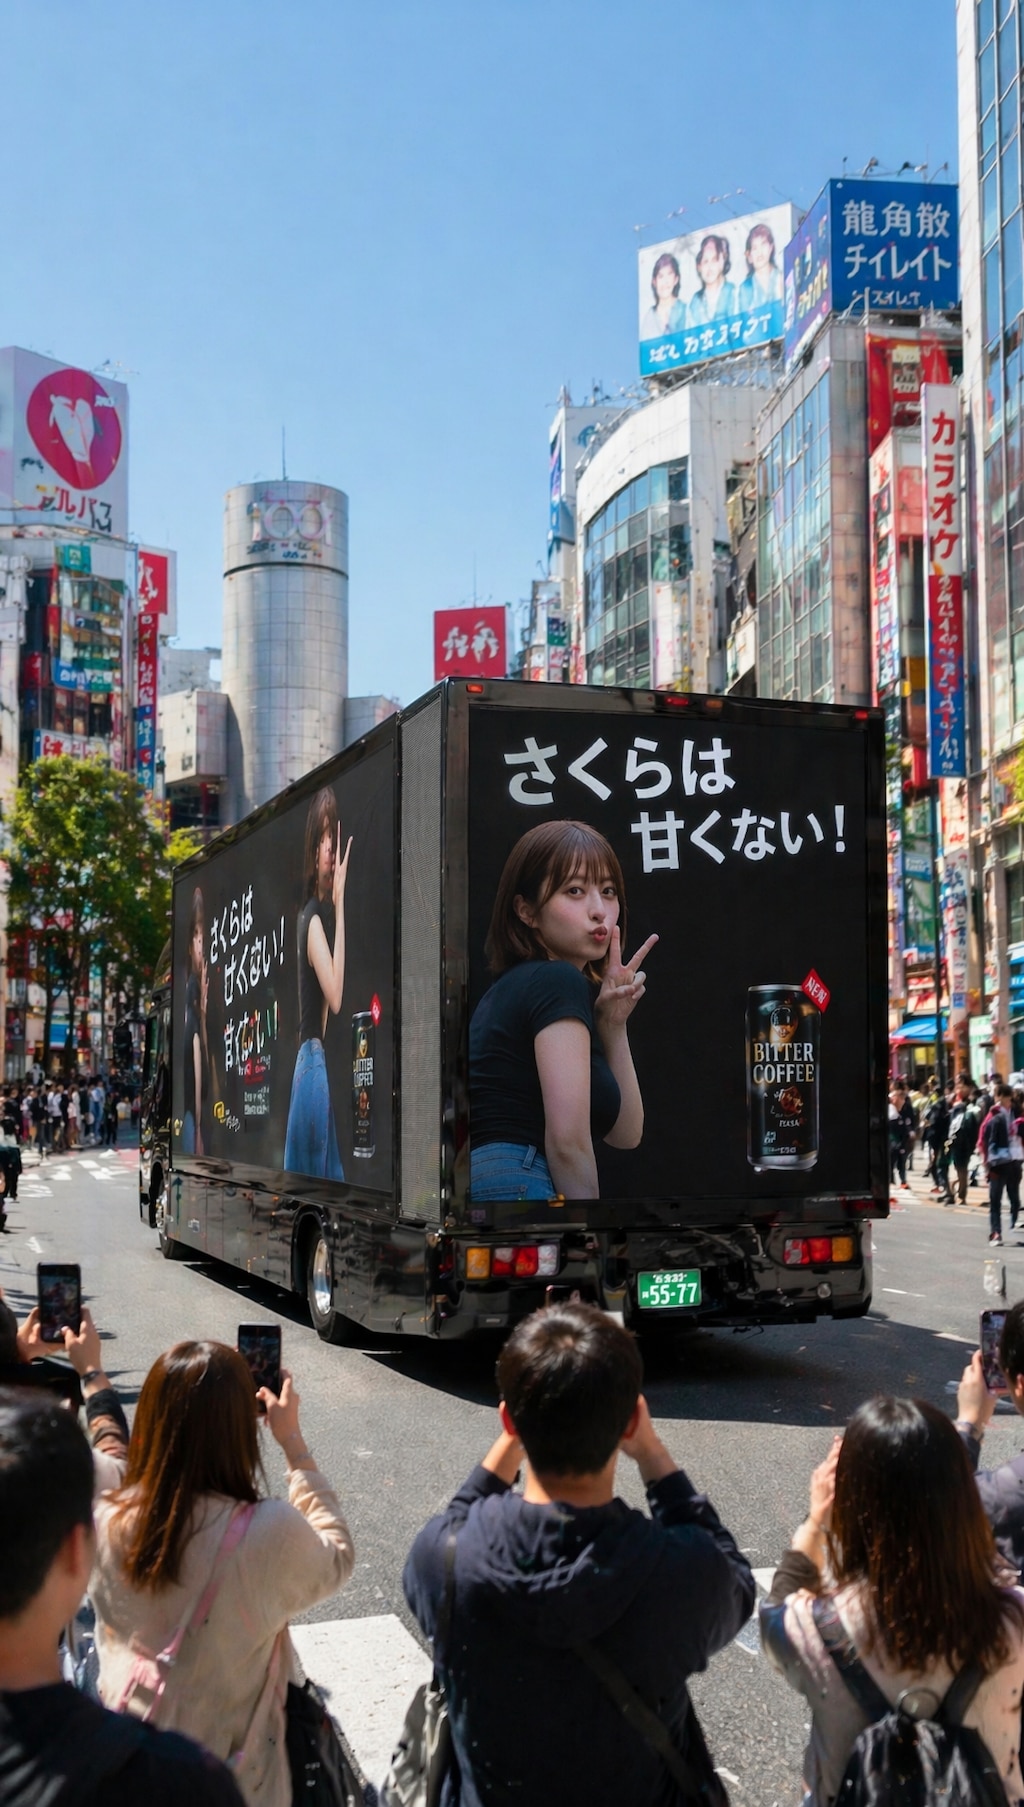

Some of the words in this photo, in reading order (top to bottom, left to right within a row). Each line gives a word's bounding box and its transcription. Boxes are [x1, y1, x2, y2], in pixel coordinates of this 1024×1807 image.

[842, 199, 951, 240] 龍角散
[931, 411, 960, 562] カラオケ
[503, 737, 737, 806] さくらは
[630, 804, 846, 874] 甘くない！
[209, 884, 253, 965] さくらは
[752, 1063, 815, 1085] COFFEE
[753, 1041, 815, 1063] BITTER
[649, 1282, 698, 1306] 55-77
